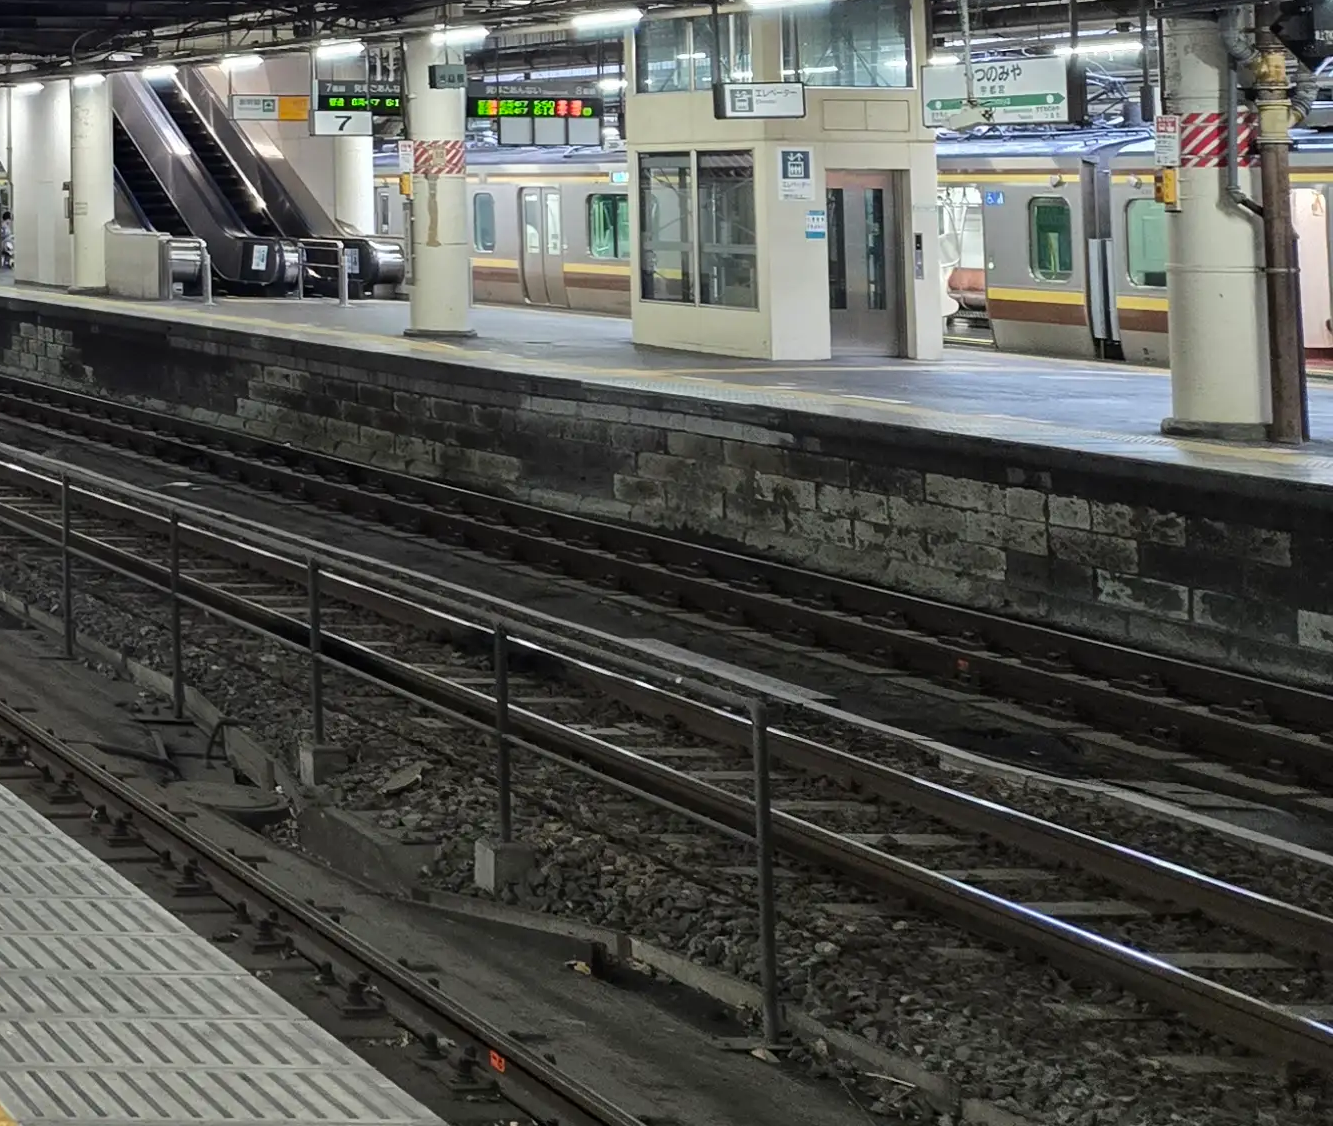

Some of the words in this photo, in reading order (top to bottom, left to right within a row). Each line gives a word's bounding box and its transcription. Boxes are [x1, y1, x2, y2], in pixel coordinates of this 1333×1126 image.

[967, 64, 1023, 83] つのみや
[334, 115, 353, 132] 7
